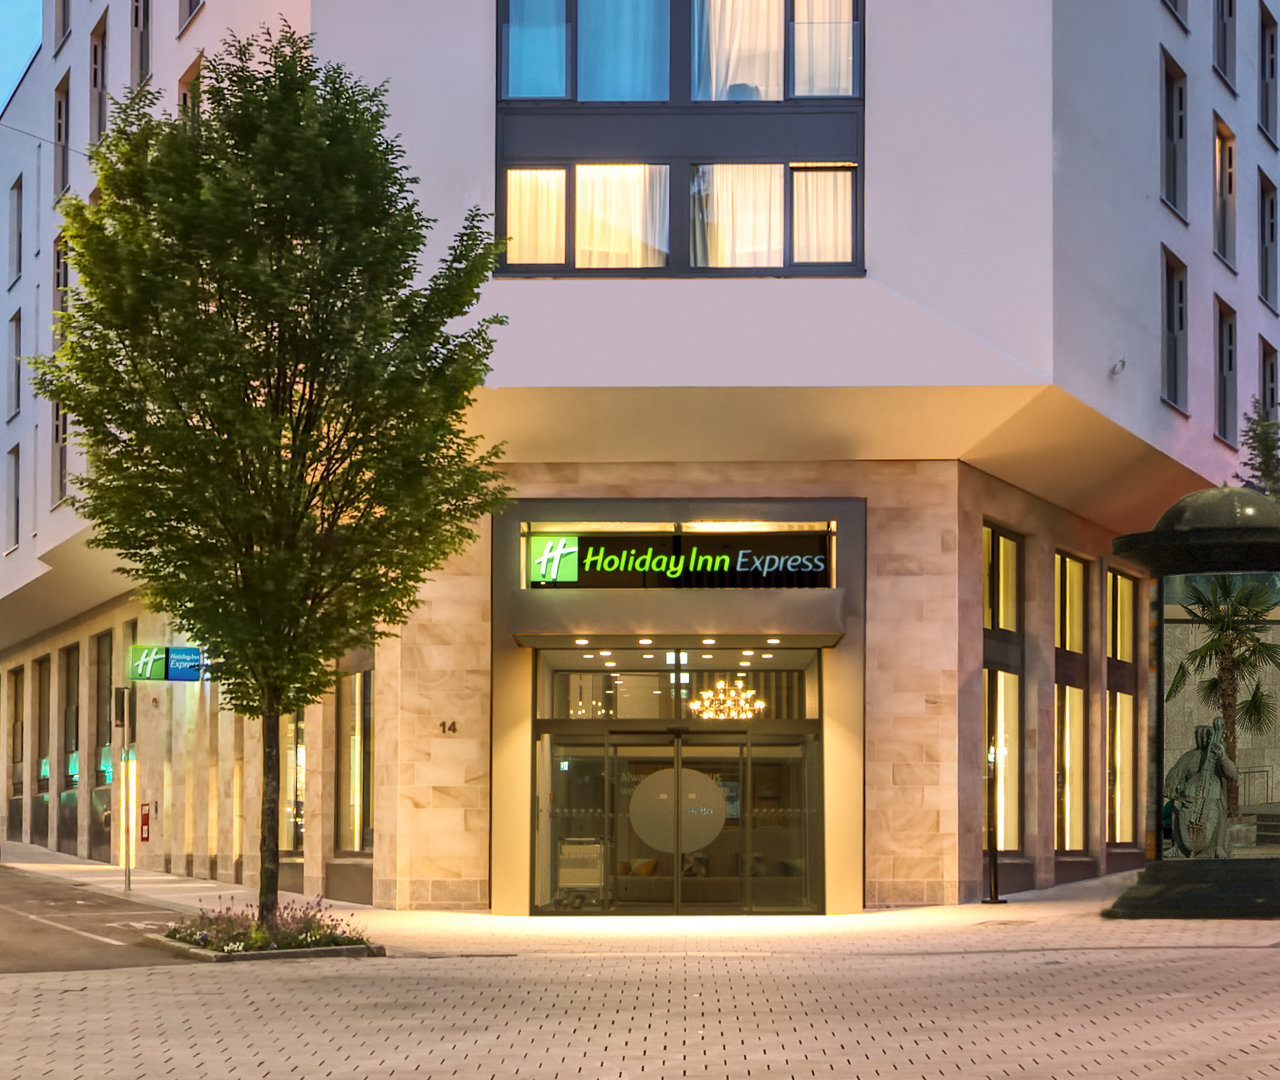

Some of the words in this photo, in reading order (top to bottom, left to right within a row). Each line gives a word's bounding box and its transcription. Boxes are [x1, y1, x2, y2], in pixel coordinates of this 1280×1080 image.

[583, 547, 684, 577] Holiday
[689, 547, 729, 572] Inn
[736, 550, 825, 577] Express
[440, 721, 457, 734] 14
